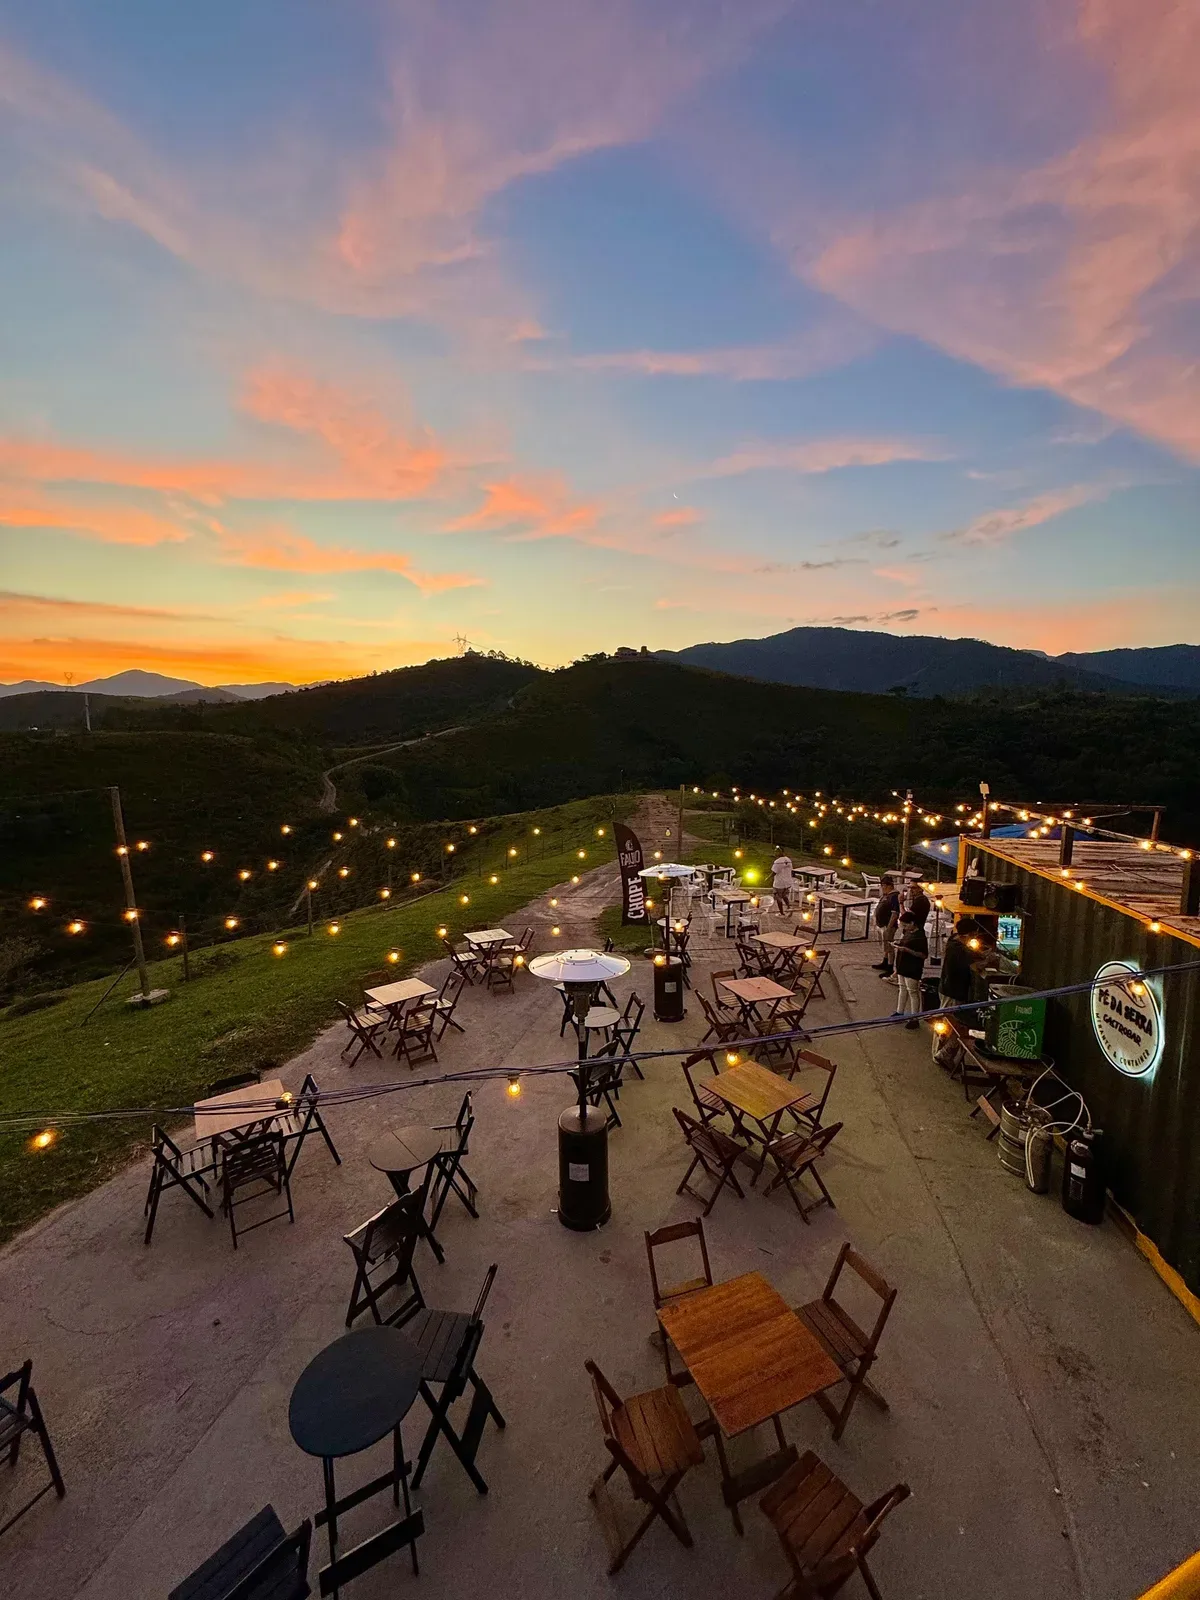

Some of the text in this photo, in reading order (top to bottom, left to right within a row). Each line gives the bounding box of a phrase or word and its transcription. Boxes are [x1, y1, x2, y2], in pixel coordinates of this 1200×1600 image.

[627, 876, 645, 919] CHOPE
[1098, 988, 1153, 1037] PÉ DA SERRA
[1103, 1014, 1142, 1047] GASTROBAR
[1095, 1012, 1112, 1051] MIRANTE
[1120, 1049, 1150, 1067] CONTAINER
